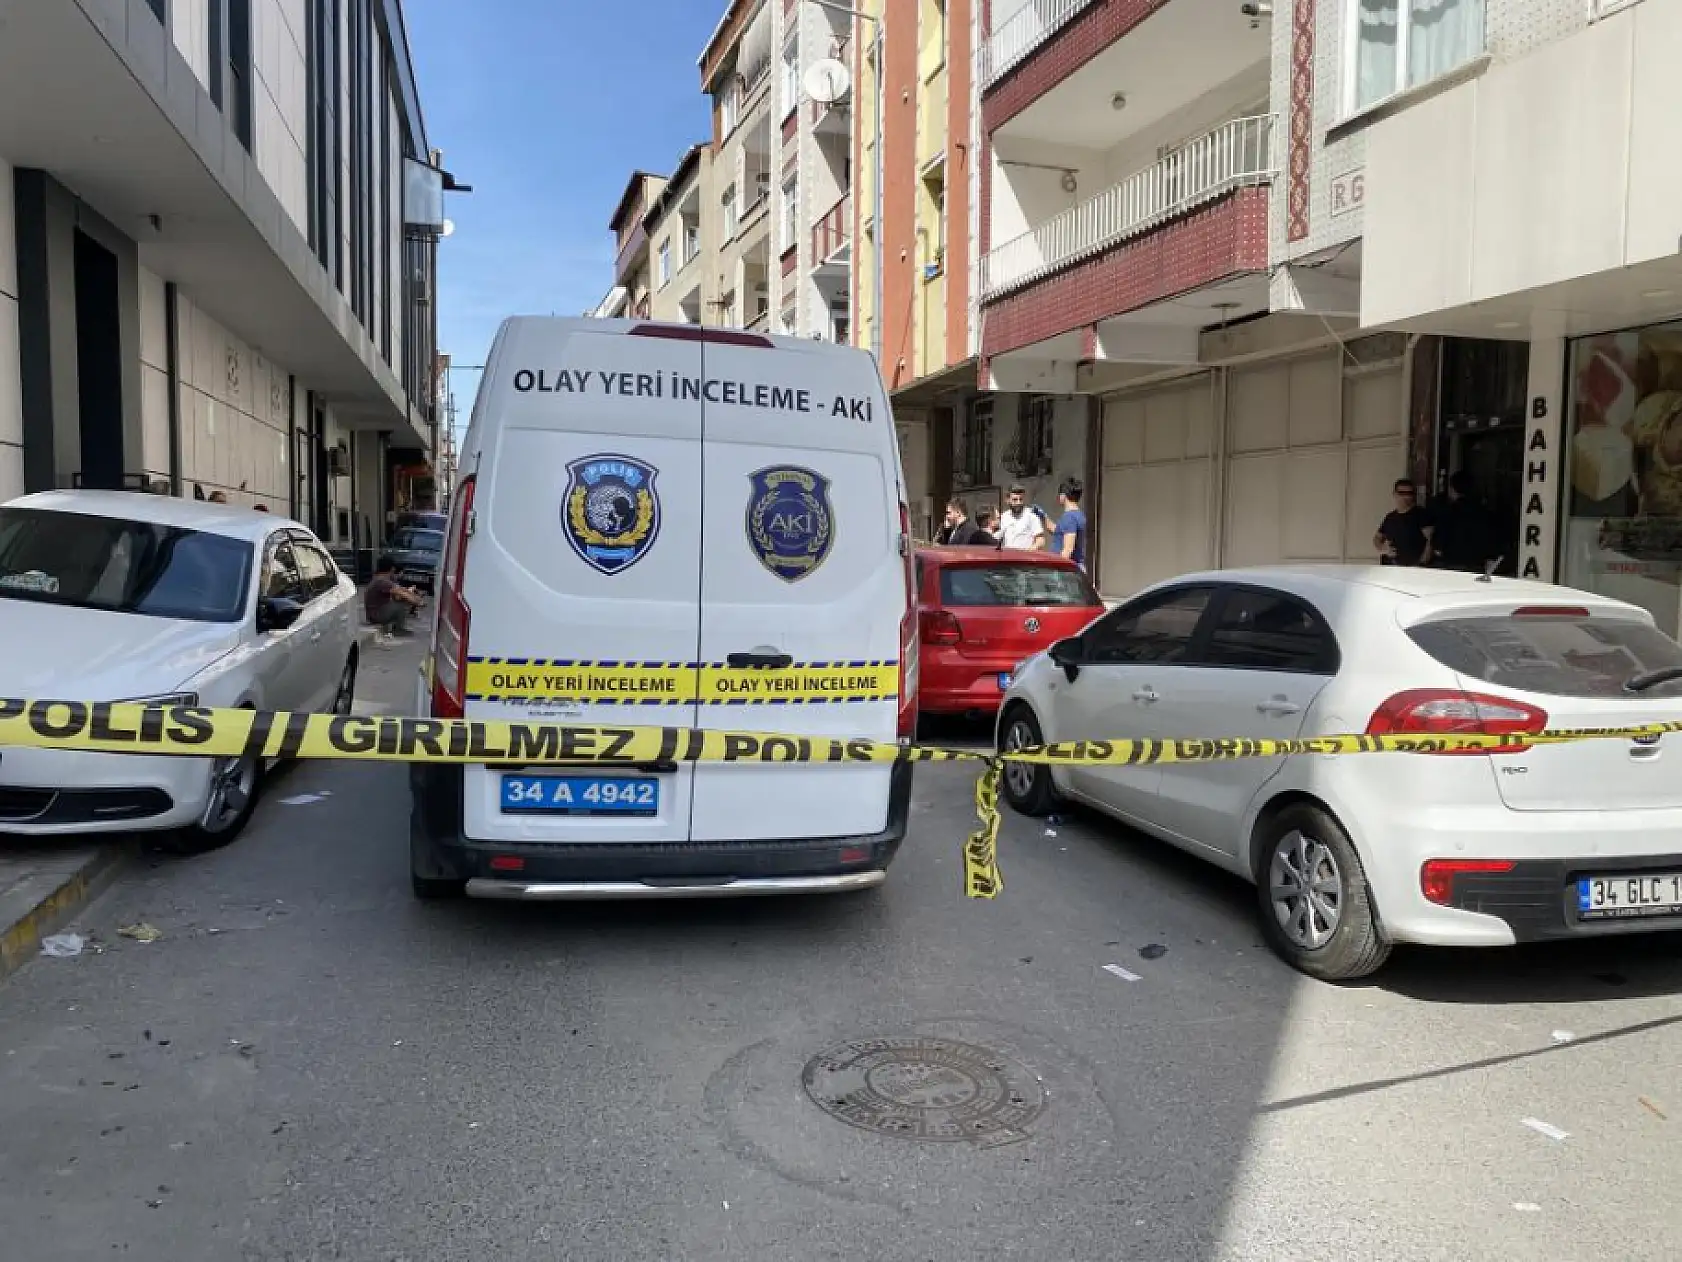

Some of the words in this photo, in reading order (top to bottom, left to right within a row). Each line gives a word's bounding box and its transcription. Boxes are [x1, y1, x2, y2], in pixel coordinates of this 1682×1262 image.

[514, 369, 591, 393] OLAY
[599, 370, 663, 398] YERİ
[672, 371, 811, 413] İNCELEME
[832, 396, 872, 423] AKİ
[491, 674, 538, 689] OLAY
[544, 674, 583, 691] YERİ
[588, 674, 676, 693] İNCELEME
[716, 678, 760, 692] OLAY
[765, 675, 799, 691] YERİ
[804, 675, 877, 691] İNCELEME
[328, 716, 636, 760] GİRİLMEZ
[508, 781, 543, 802] 34
[554, 782, 574, 803] A
[583, 783, 654, 804] 4942
[1594, 880, 1617, 905] 34
[1628, 877, 1661, 903] GLC
